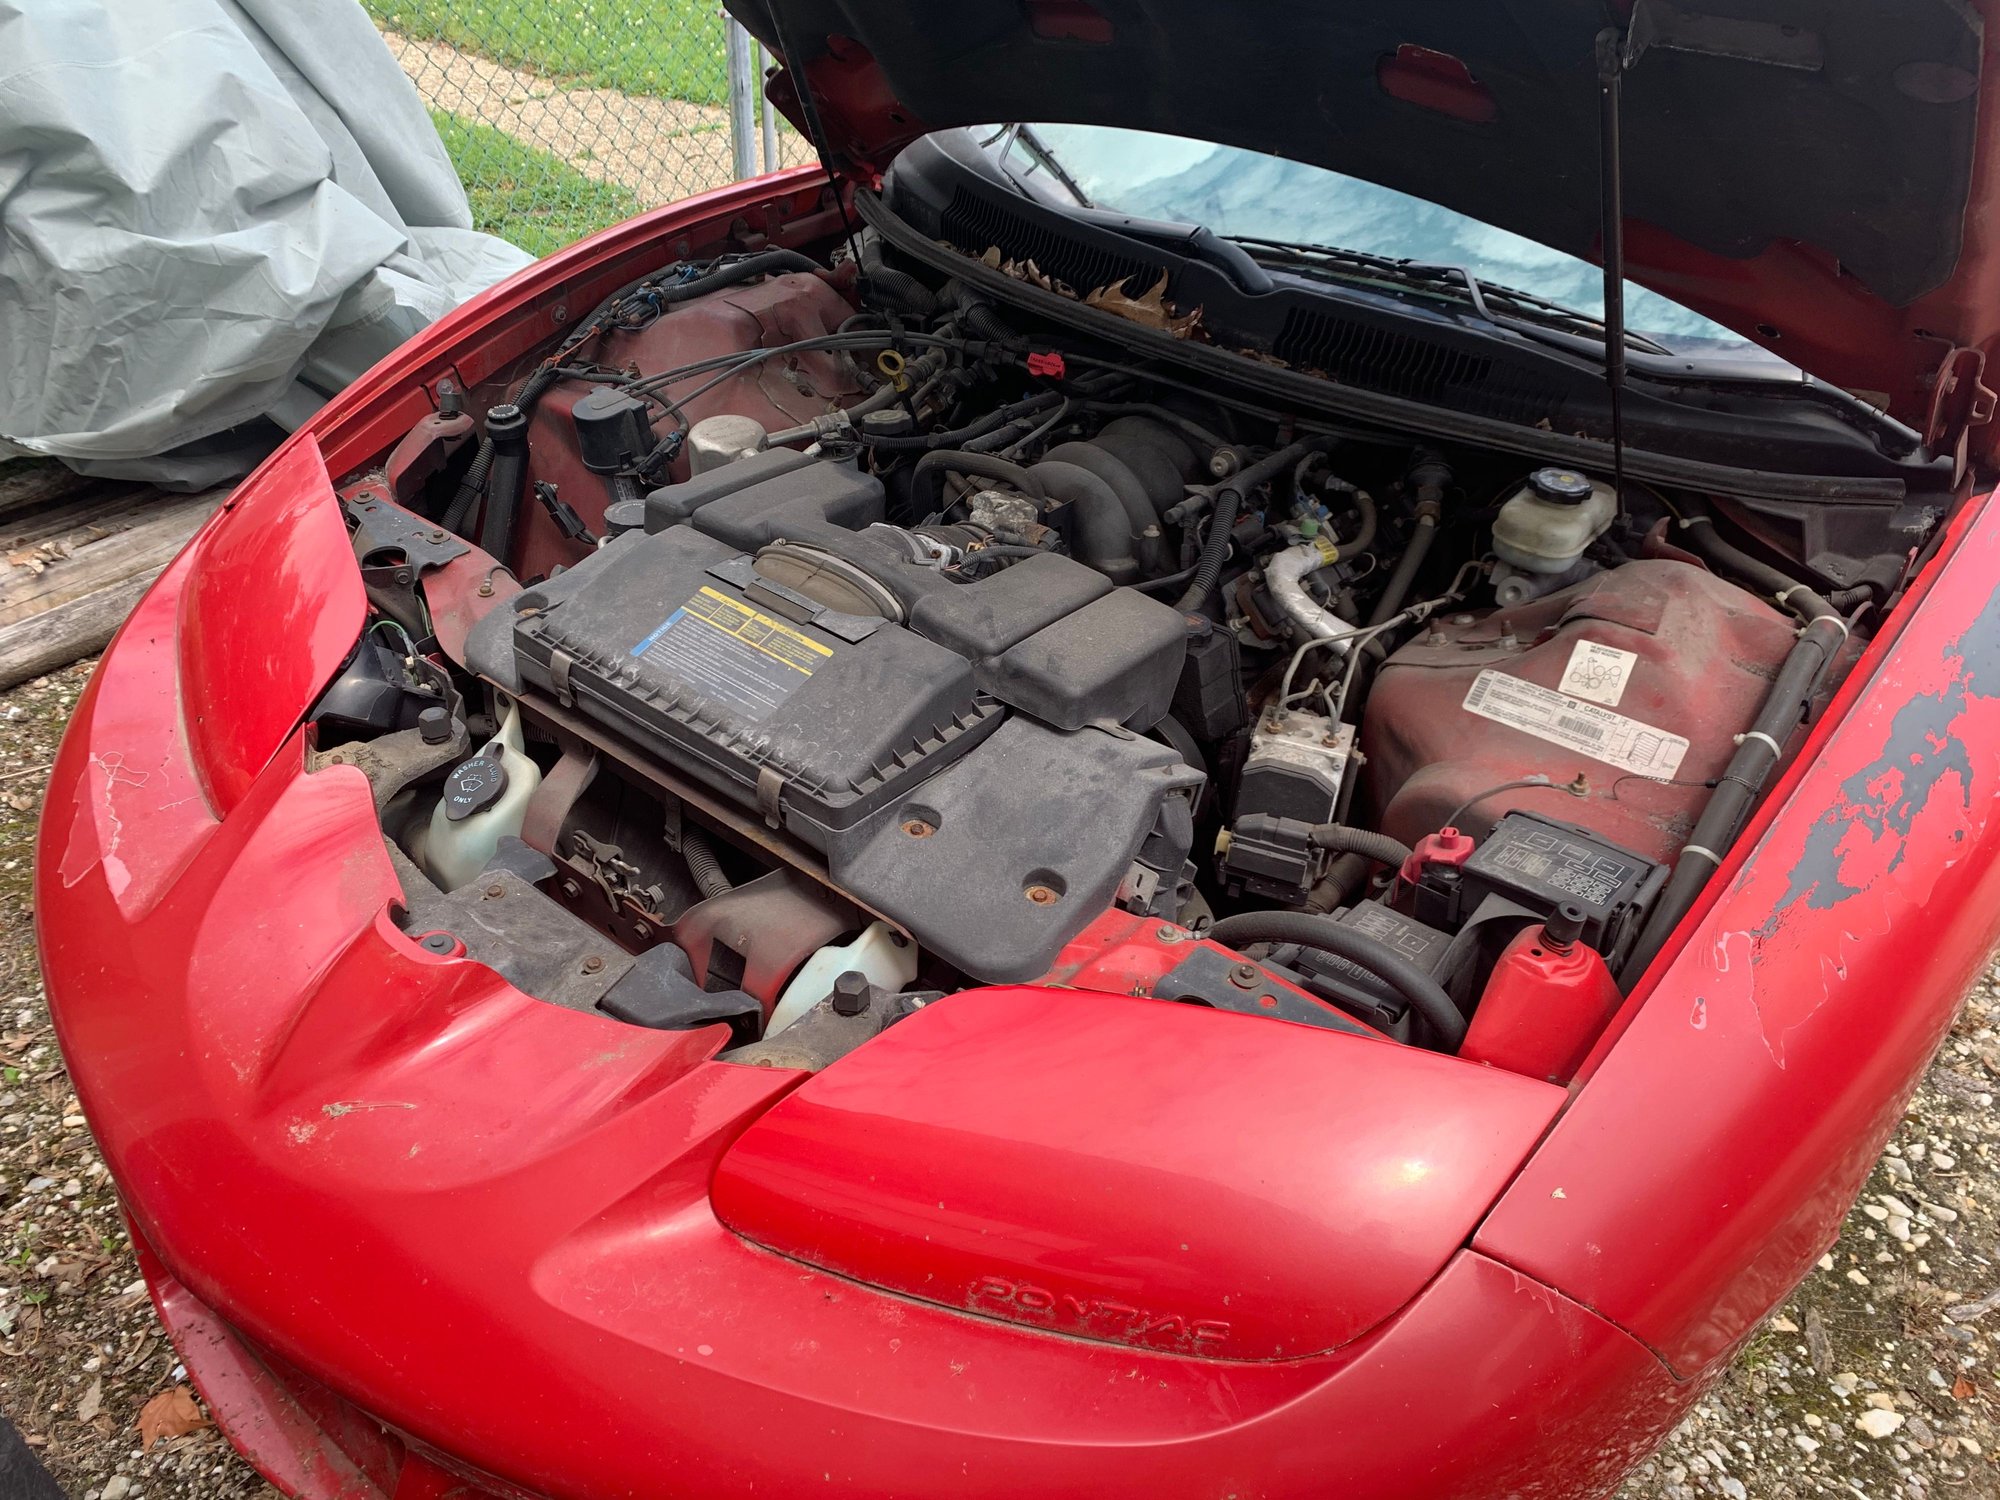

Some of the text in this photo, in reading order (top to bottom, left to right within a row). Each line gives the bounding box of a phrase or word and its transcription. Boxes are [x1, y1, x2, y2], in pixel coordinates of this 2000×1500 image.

[648, 620, 672, 642] NOTICE
[1583, 705, 1617, 721] CATALYST
[452, 760, 499, 783] WASHER FLUID
[453, 795, 473, 804] ONLY
